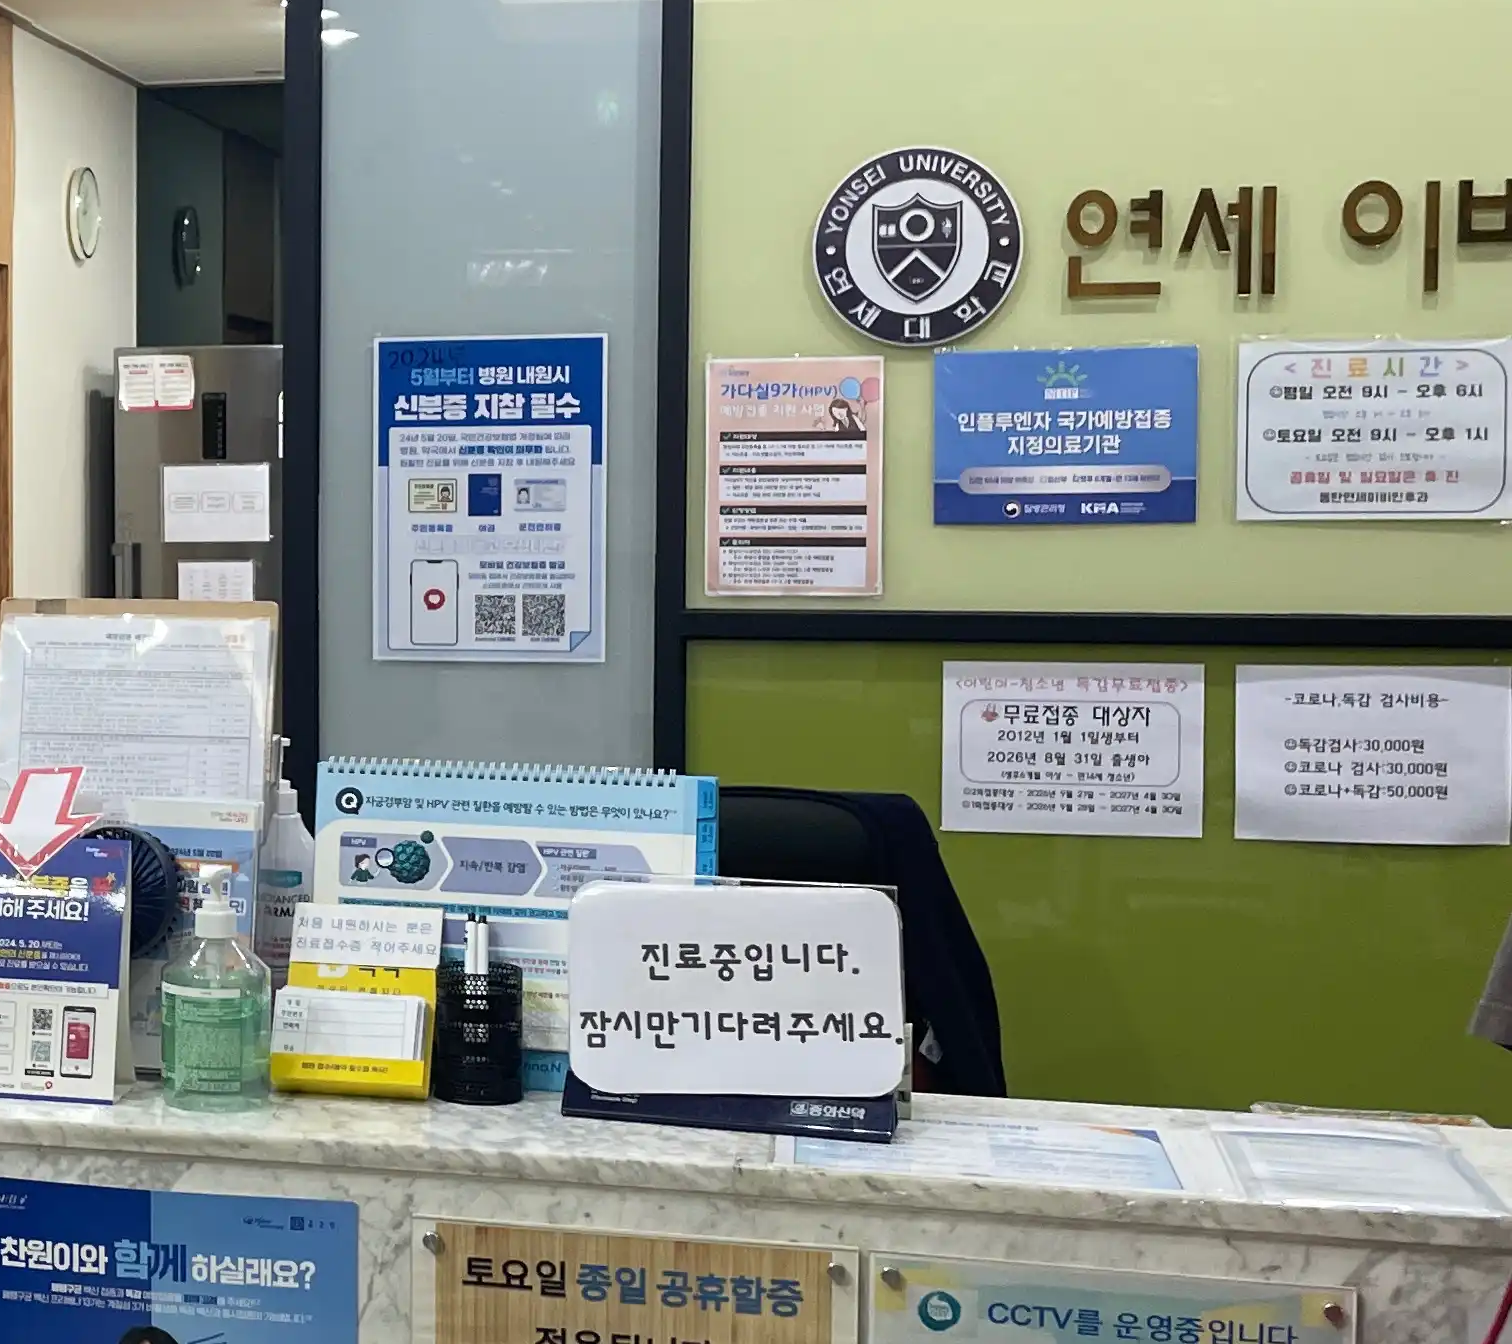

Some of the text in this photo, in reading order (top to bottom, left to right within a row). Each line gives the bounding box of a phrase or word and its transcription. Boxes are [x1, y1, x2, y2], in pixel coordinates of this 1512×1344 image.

[825, 154, 1011, 235] YONSEI UNIVERSITY
[1067, 185, 1277, 298] 연세
[411, 365, 570, 386] 5월부터 병원 내원시
[1322, 386, 1353, 400] 오전
[1416, 384, 1447, 398] 오후
[394, 392, 581, 421] 신분증 지참 필수
[957, 409, 1173, 432] 인플루엔자 국가예방접종
[1008, 435, 1121, 455] 지정의료기관
[1277, 429, 1322, 443] 토요일
[1331, 429, 1361, 443] 오전
[1425, 427, 1455, 442] 오후
[1465, 427, 1489, 441] 1시
[1004, 705, 1151, 726] 무료접종 대상자
[997, 730, 1139, 745] 2012년 1월 1일생부터
[987, 752, 1036, 765] 2026년
[1044, 752, 1066, 765] 8월
[1074, 753, 1102, 767] 31일
[1298, 761, 1342, 776] 코로나
[426, 799, 450, 809] HPV
[451, 799, 470, 811] 관련
[473, 801, 501, 812] 질환을
[536, 804, 544, 815] 수
[547, 804, 566, 816] 있는
[570, 805, 600, 818] 방법은
[601, 806, 630, 819] 무엇이
[27, 899, 89, 922] 주세요!
[297, 916, 433, 934] 처음 내원하시는 분은
[296, 937, 437, 956] 진료접수증 적어주세요
[641, 943, 860, 982] 진료중입니다.
[580, 1010, 904, 1049] 잠시만기다려주세요.
[0, 1236, 316, 1291] 찬원이와 함께 하실래요?
[462, 1257, 805, 1318] 토요일 종일 공휴할증
[989, 1302, 1102, 1337] CCTV를
